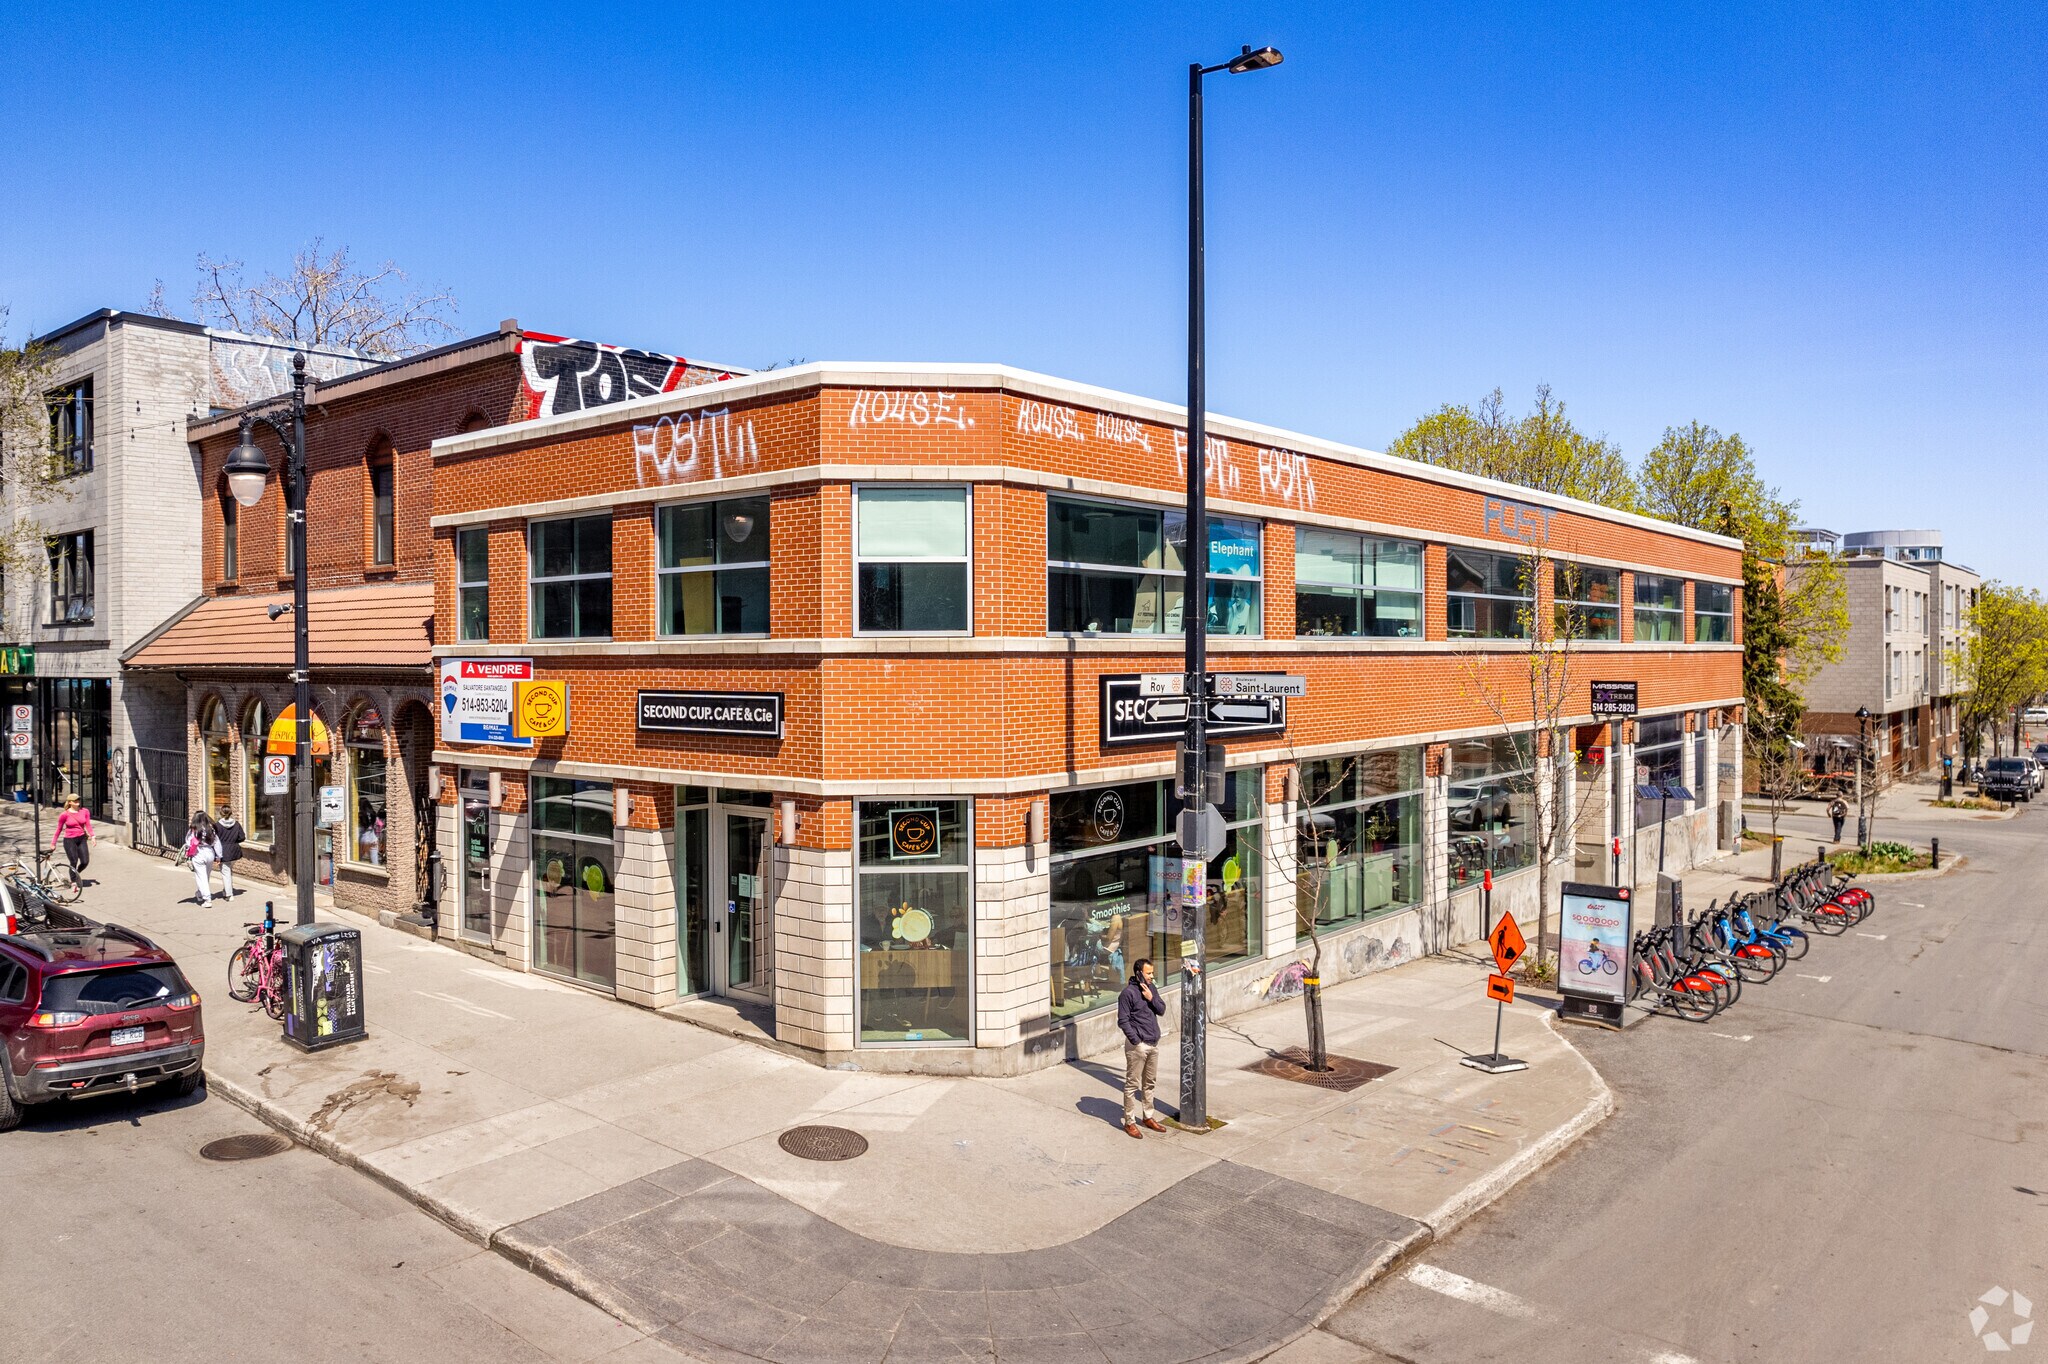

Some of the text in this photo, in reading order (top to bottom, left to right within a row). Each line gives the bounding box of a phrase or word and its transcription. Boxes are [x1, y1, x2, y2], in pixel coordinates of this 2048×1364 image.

[1211, 541, 1254, 557] Elephant
[477, 664, 523, 674] VENDRE
[484, 684, 507, 692] SANTANGELO
[1150, 682, 1166, 693] Roy
[1235, 682, 1300, 694] Saint-Laurent
[462, 698, 508, 713] 514-953-5204
[527, 691, 558, 706] SECOND CUP
[643, 704, 688, 719] SECOND
[744, 707, 753, 721] &
[753, 708, 773, 722] Cie
[1592, 703, 1635, 712] 514 285-2828
[1097, 795, 1121, 814] SECOND CUP
[898, 817, 931, 832] SECOND CUP
[1091, 902, 1131, 920] Smoothies
[1572, 914, 1582, 922] 50
